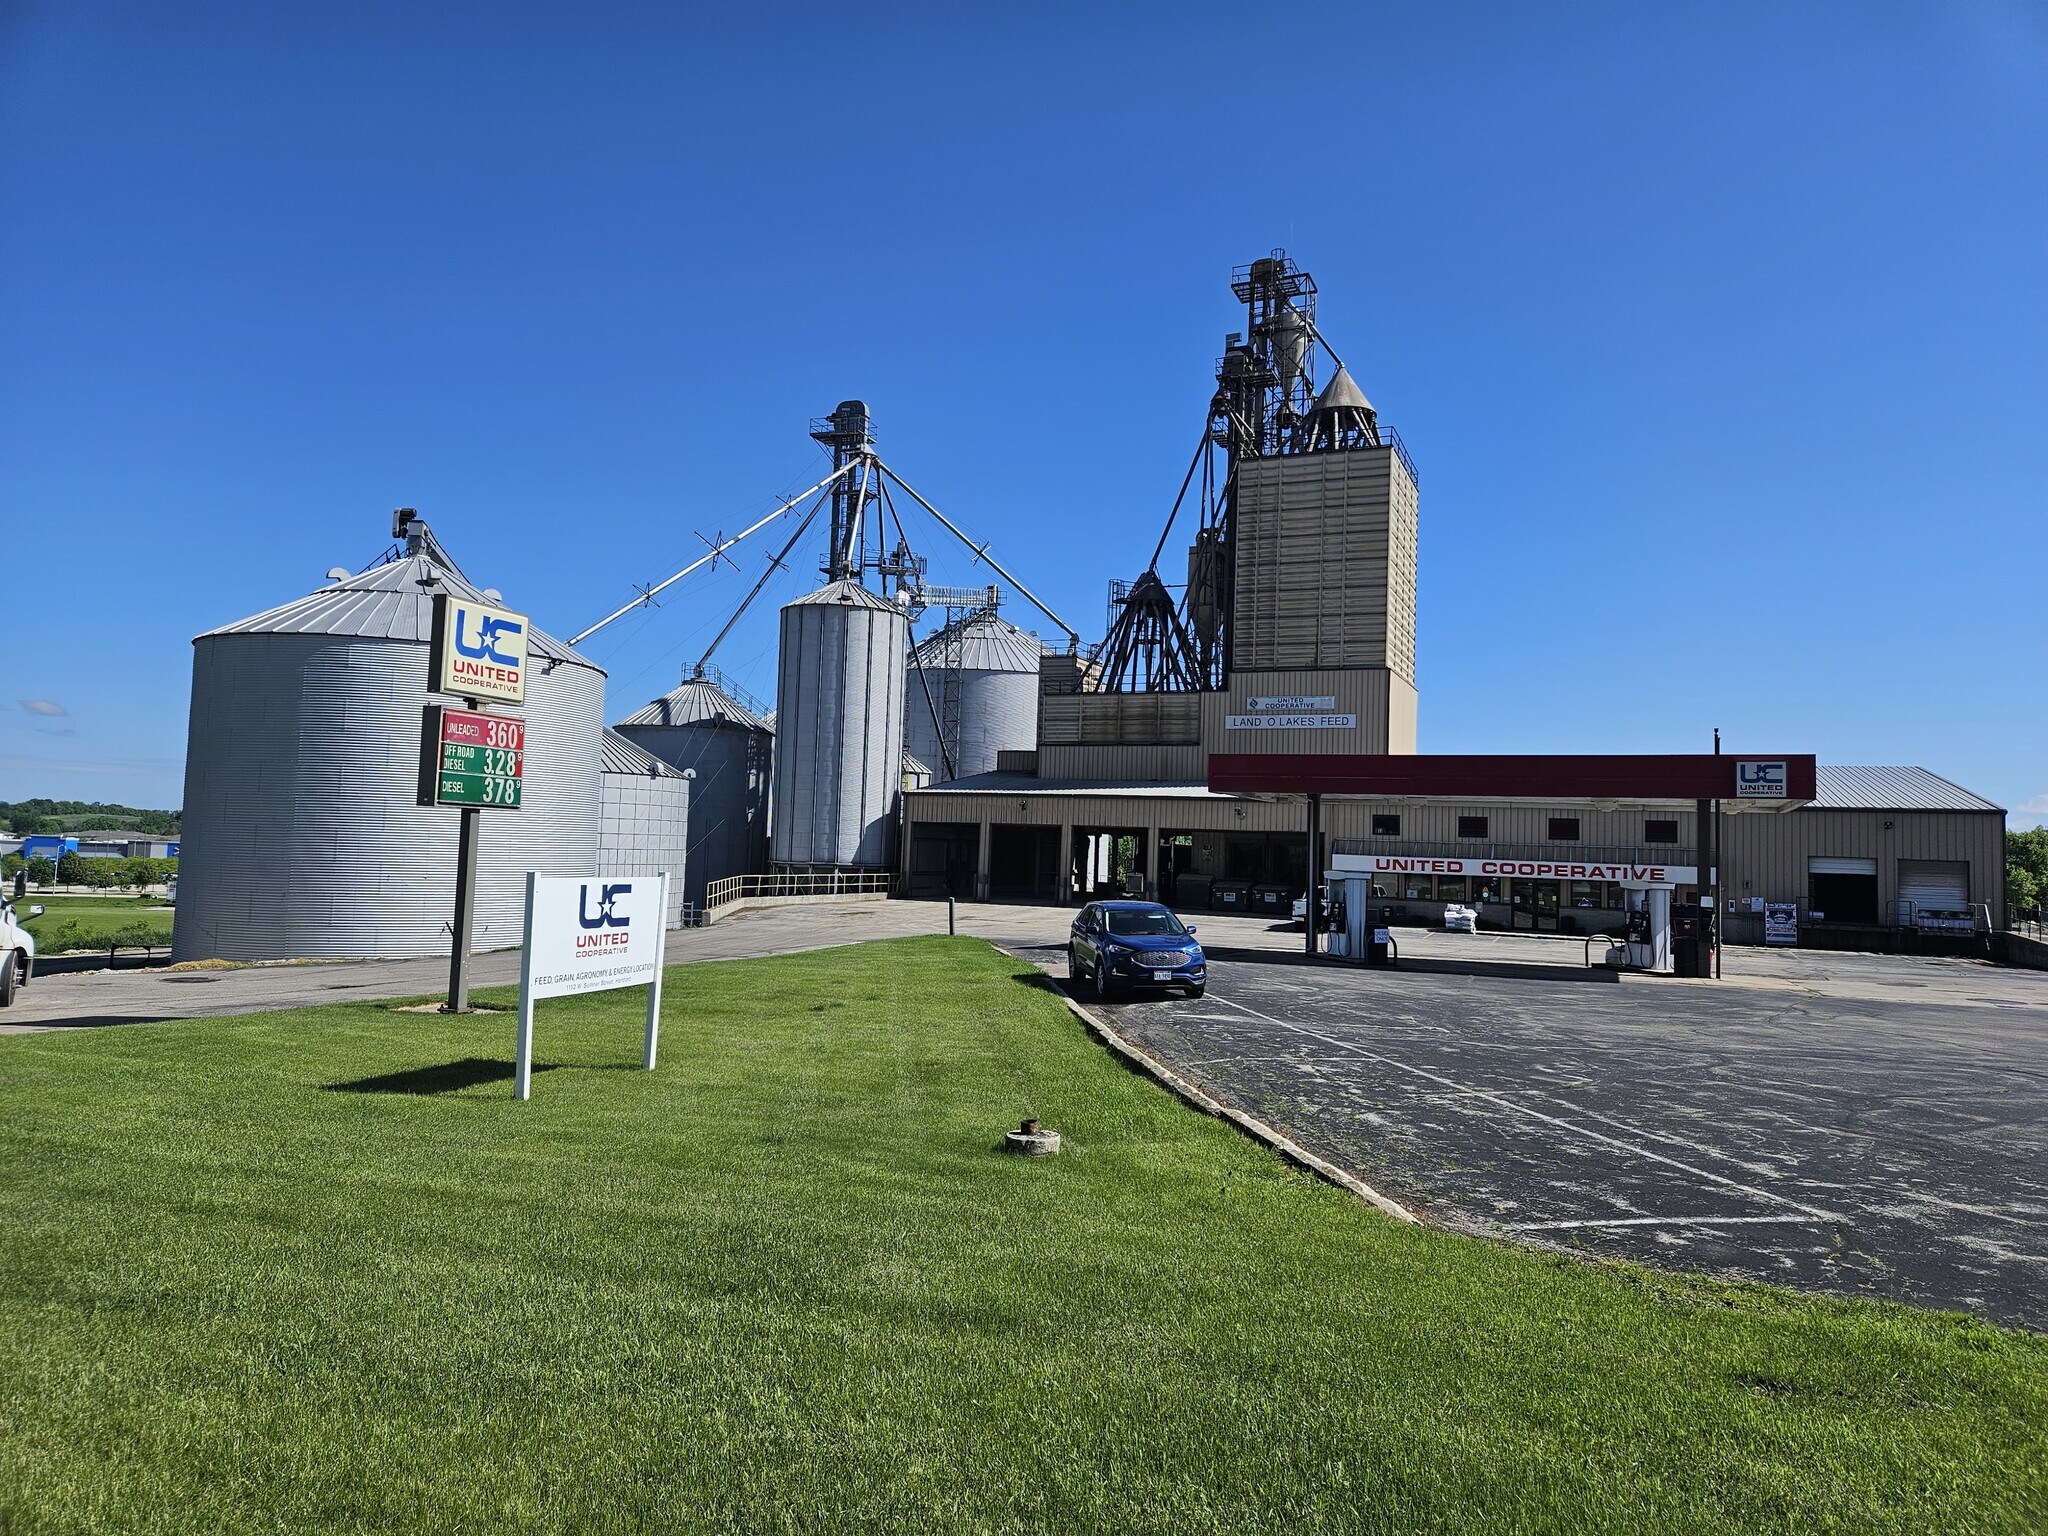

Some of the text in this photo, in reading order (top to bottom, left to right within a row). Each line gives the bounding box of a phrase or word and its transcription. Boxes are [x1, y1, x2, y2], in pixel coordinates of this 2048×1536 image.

[455, 608, 522, 668] UC
[454, 660, 519, 684] UNITED
[452, 675, 518, 693] COOPERATIVE
[447, 722, 480, 737] UNLEADED
[1234, 717, 1349, 726] LAND O LAKES FEED
[444, 744, 475, 758] OFF ROAD
[444, 758, 465, 771] DIESEL
[484, 749, 516, 776] 3.28
[1740, 764, 1783, 783] UC
[442, 781, 464, 793] DIESEL
[1375, 858, 1665, 880] UNITED COOPERATIVE
[579, 884, 632, 929] UC
[576, 932, 629, 948] UNITED
[576, 947, 628, 958] COOPERATIVE
[576, 969, 608, 980] AGRONOMY
[613, 966, 632, 975] ENERGY
[633, 963, 654, 973] LOCATION
